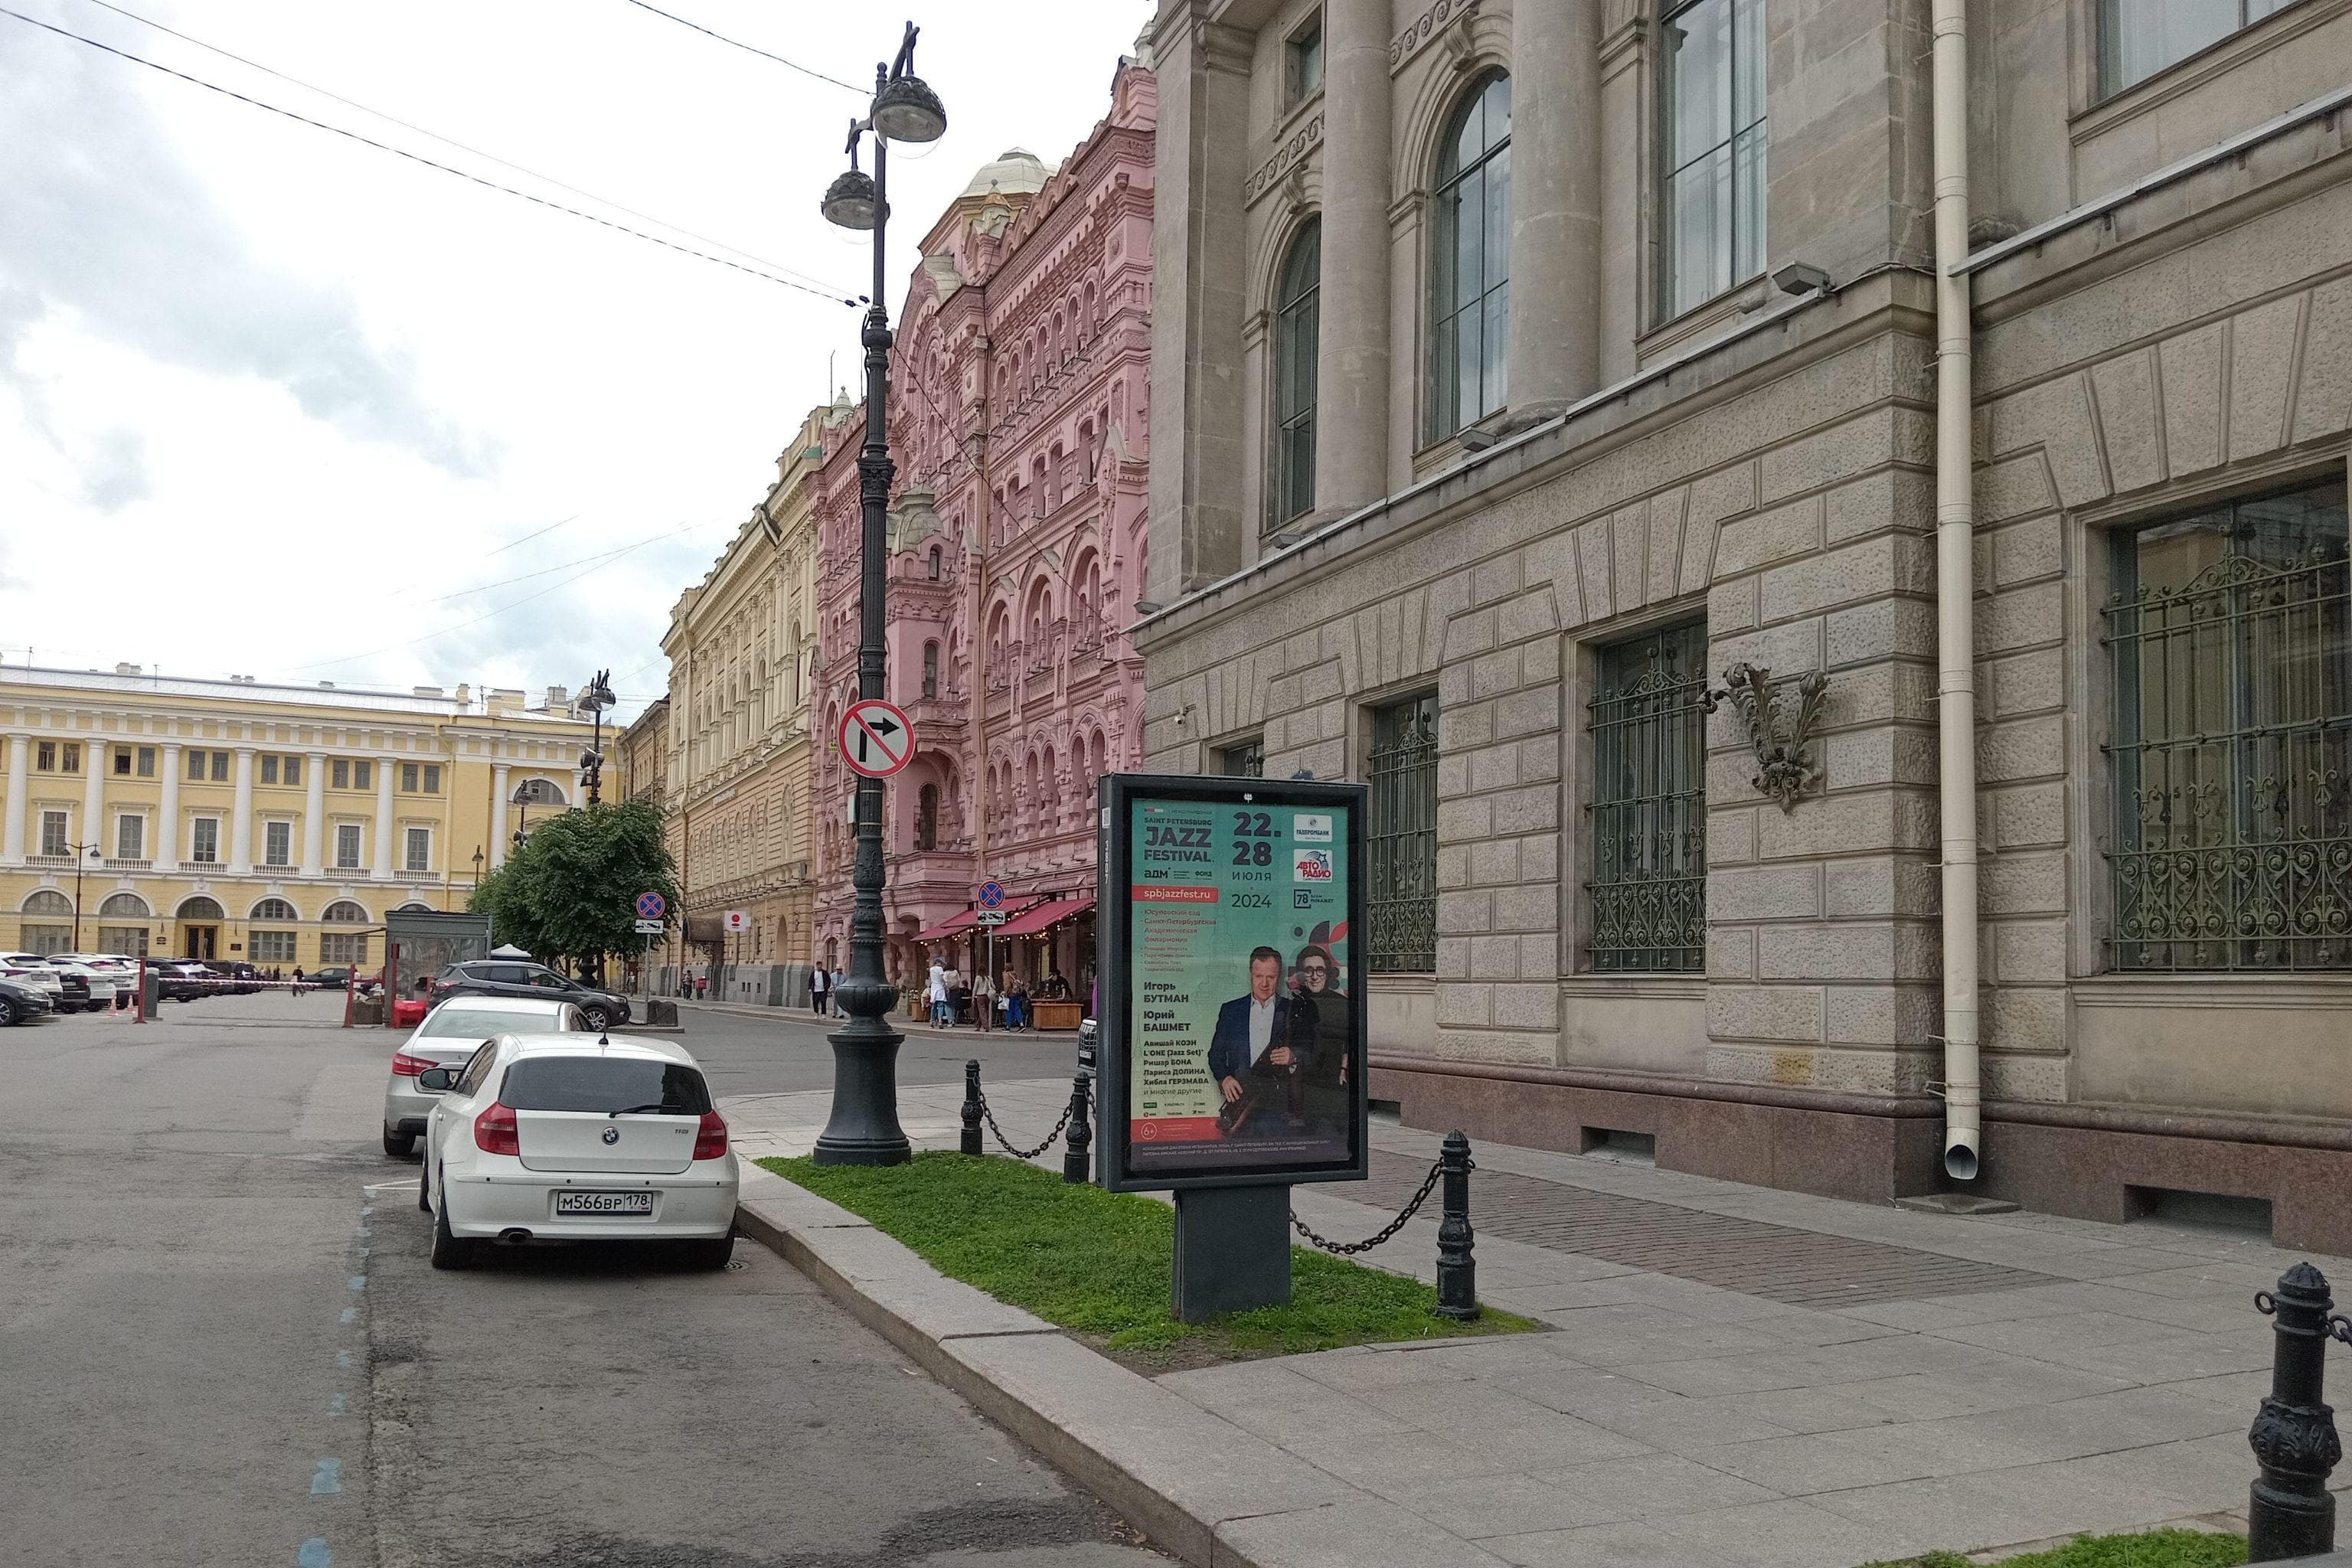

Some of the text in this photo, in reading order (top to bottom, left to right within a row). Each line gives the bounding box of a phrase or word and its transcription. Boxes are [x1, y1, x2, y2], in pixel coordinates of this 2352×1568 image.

[1145, 826, 1212, 848] JAZZ
[1144, 849, 1214, 863] FESTIVAL.
[1231, 841, 1272, 867] 28
[1296, 861, 1319, 870] АВТО
[1302, 870, 1331, 878] РАДИО
[1144, 888, 1210, 900] spbjazzfest.ru
[1296, 893, 1308, 905] 78
[1231, 894, 1272, 908] 2024
[1144, 982, 1176, 992] Игорь
[1144, 995, 1189, 1003] БУТМАН
[1143, 1010, 1174, 1021] Юрий
[1143, 1023, 1191, 1032] БАШМЕТ
[1144, 1127, 1155, 1135] 6+
[626, 1194, 648, 1206] 178
